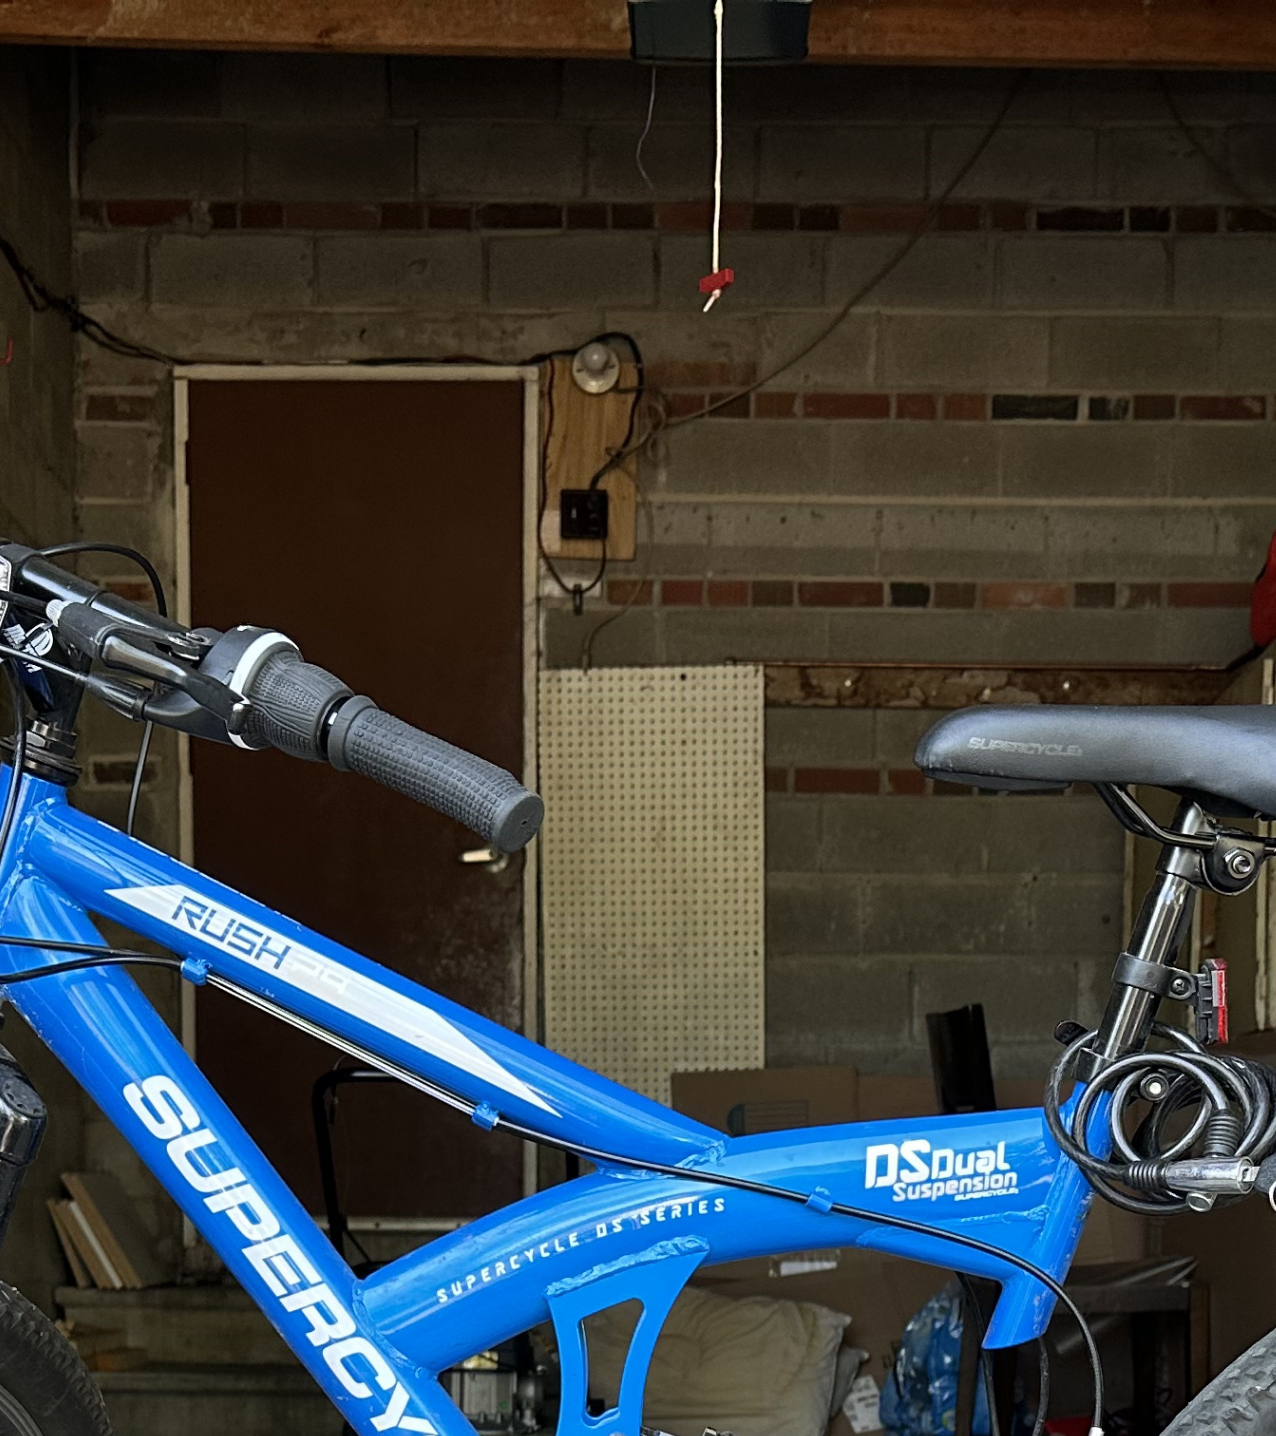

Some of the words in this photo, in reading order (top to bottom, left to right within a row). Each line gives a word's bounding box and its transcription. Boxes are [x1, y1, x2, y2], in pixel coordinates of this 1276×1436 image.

[172, 896, 291, 969] RUSH
[865, 1139, 931, 1189] DS
[931, 1141, 1011, 1179] Dual
[892, 1170, 1018, 1202] Suspension
[436, 1232, 579, 1303] SUPERCYCLE
[596, 1219, 623, 1238] DS
[639, 1198, 726, 1226] SERIES
